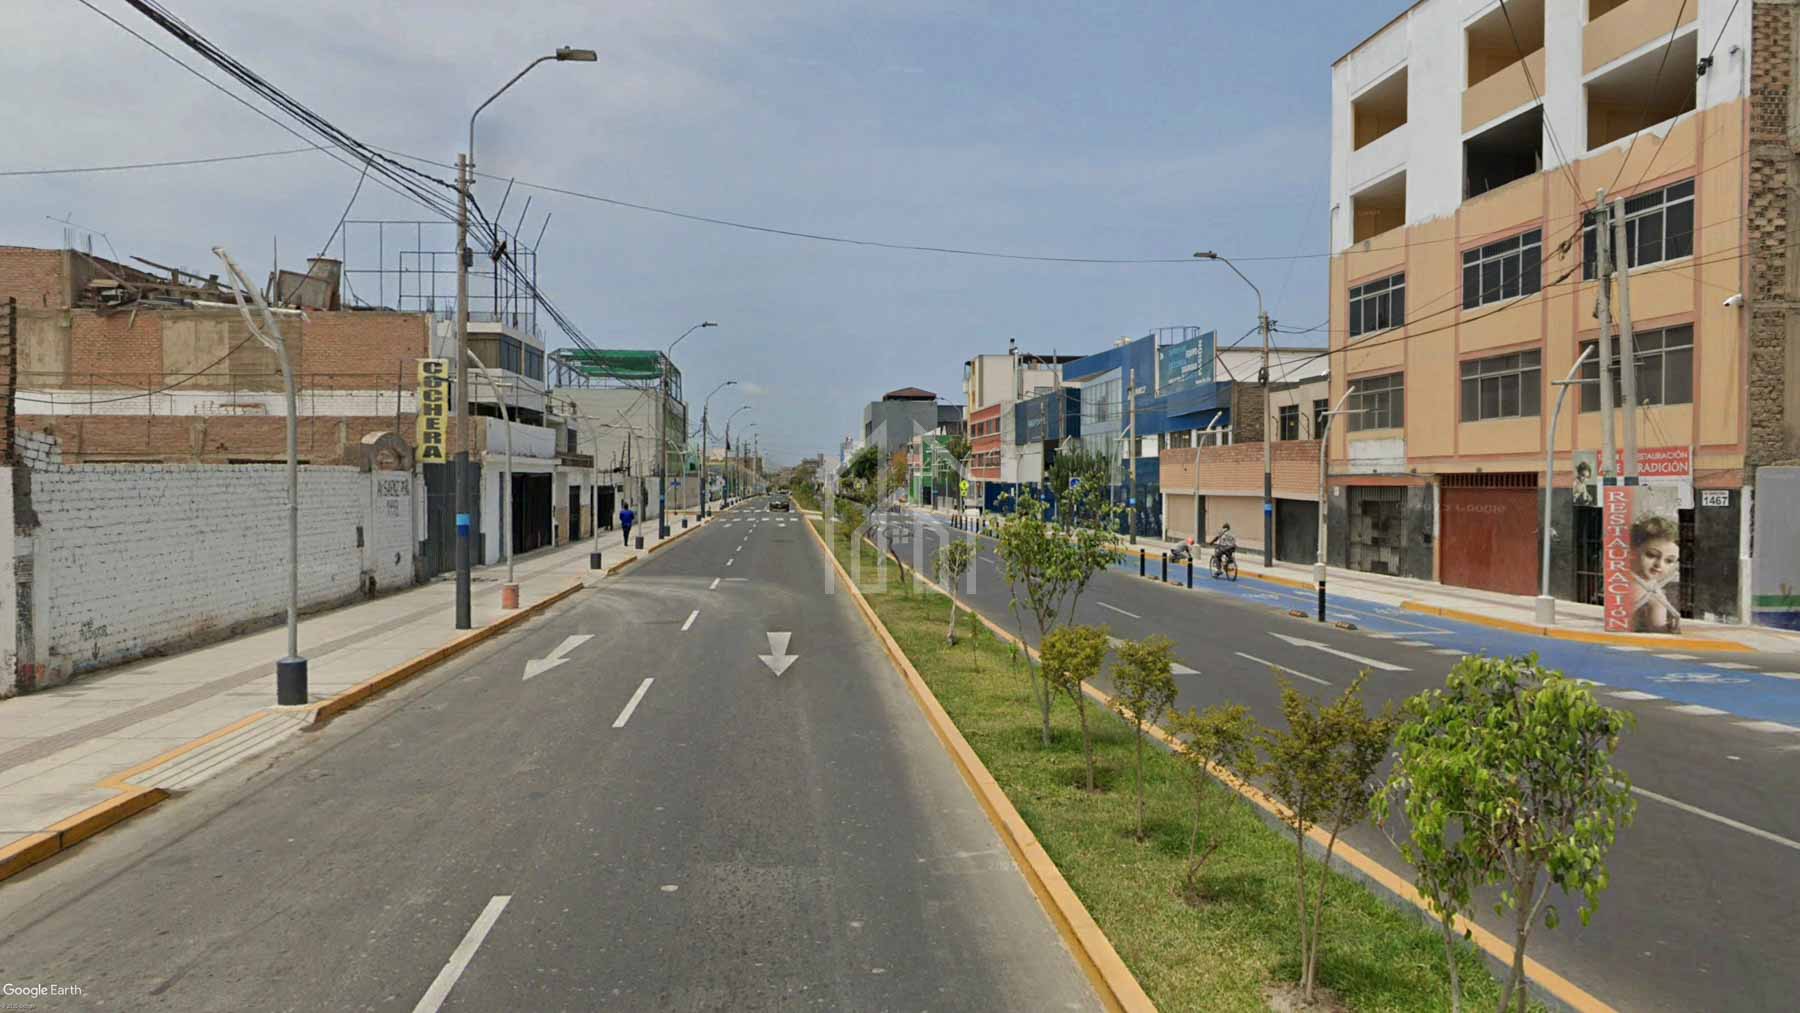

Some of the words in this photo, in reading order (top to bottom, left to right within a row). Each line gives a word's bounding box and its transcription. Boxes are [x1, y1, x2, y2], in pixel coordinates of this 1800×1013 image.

[423, 361, 443, 458] COCHERA
[1638, 460, 1688, 473] RADICIÓN
[1703, 496, 1728, 505] 1467
